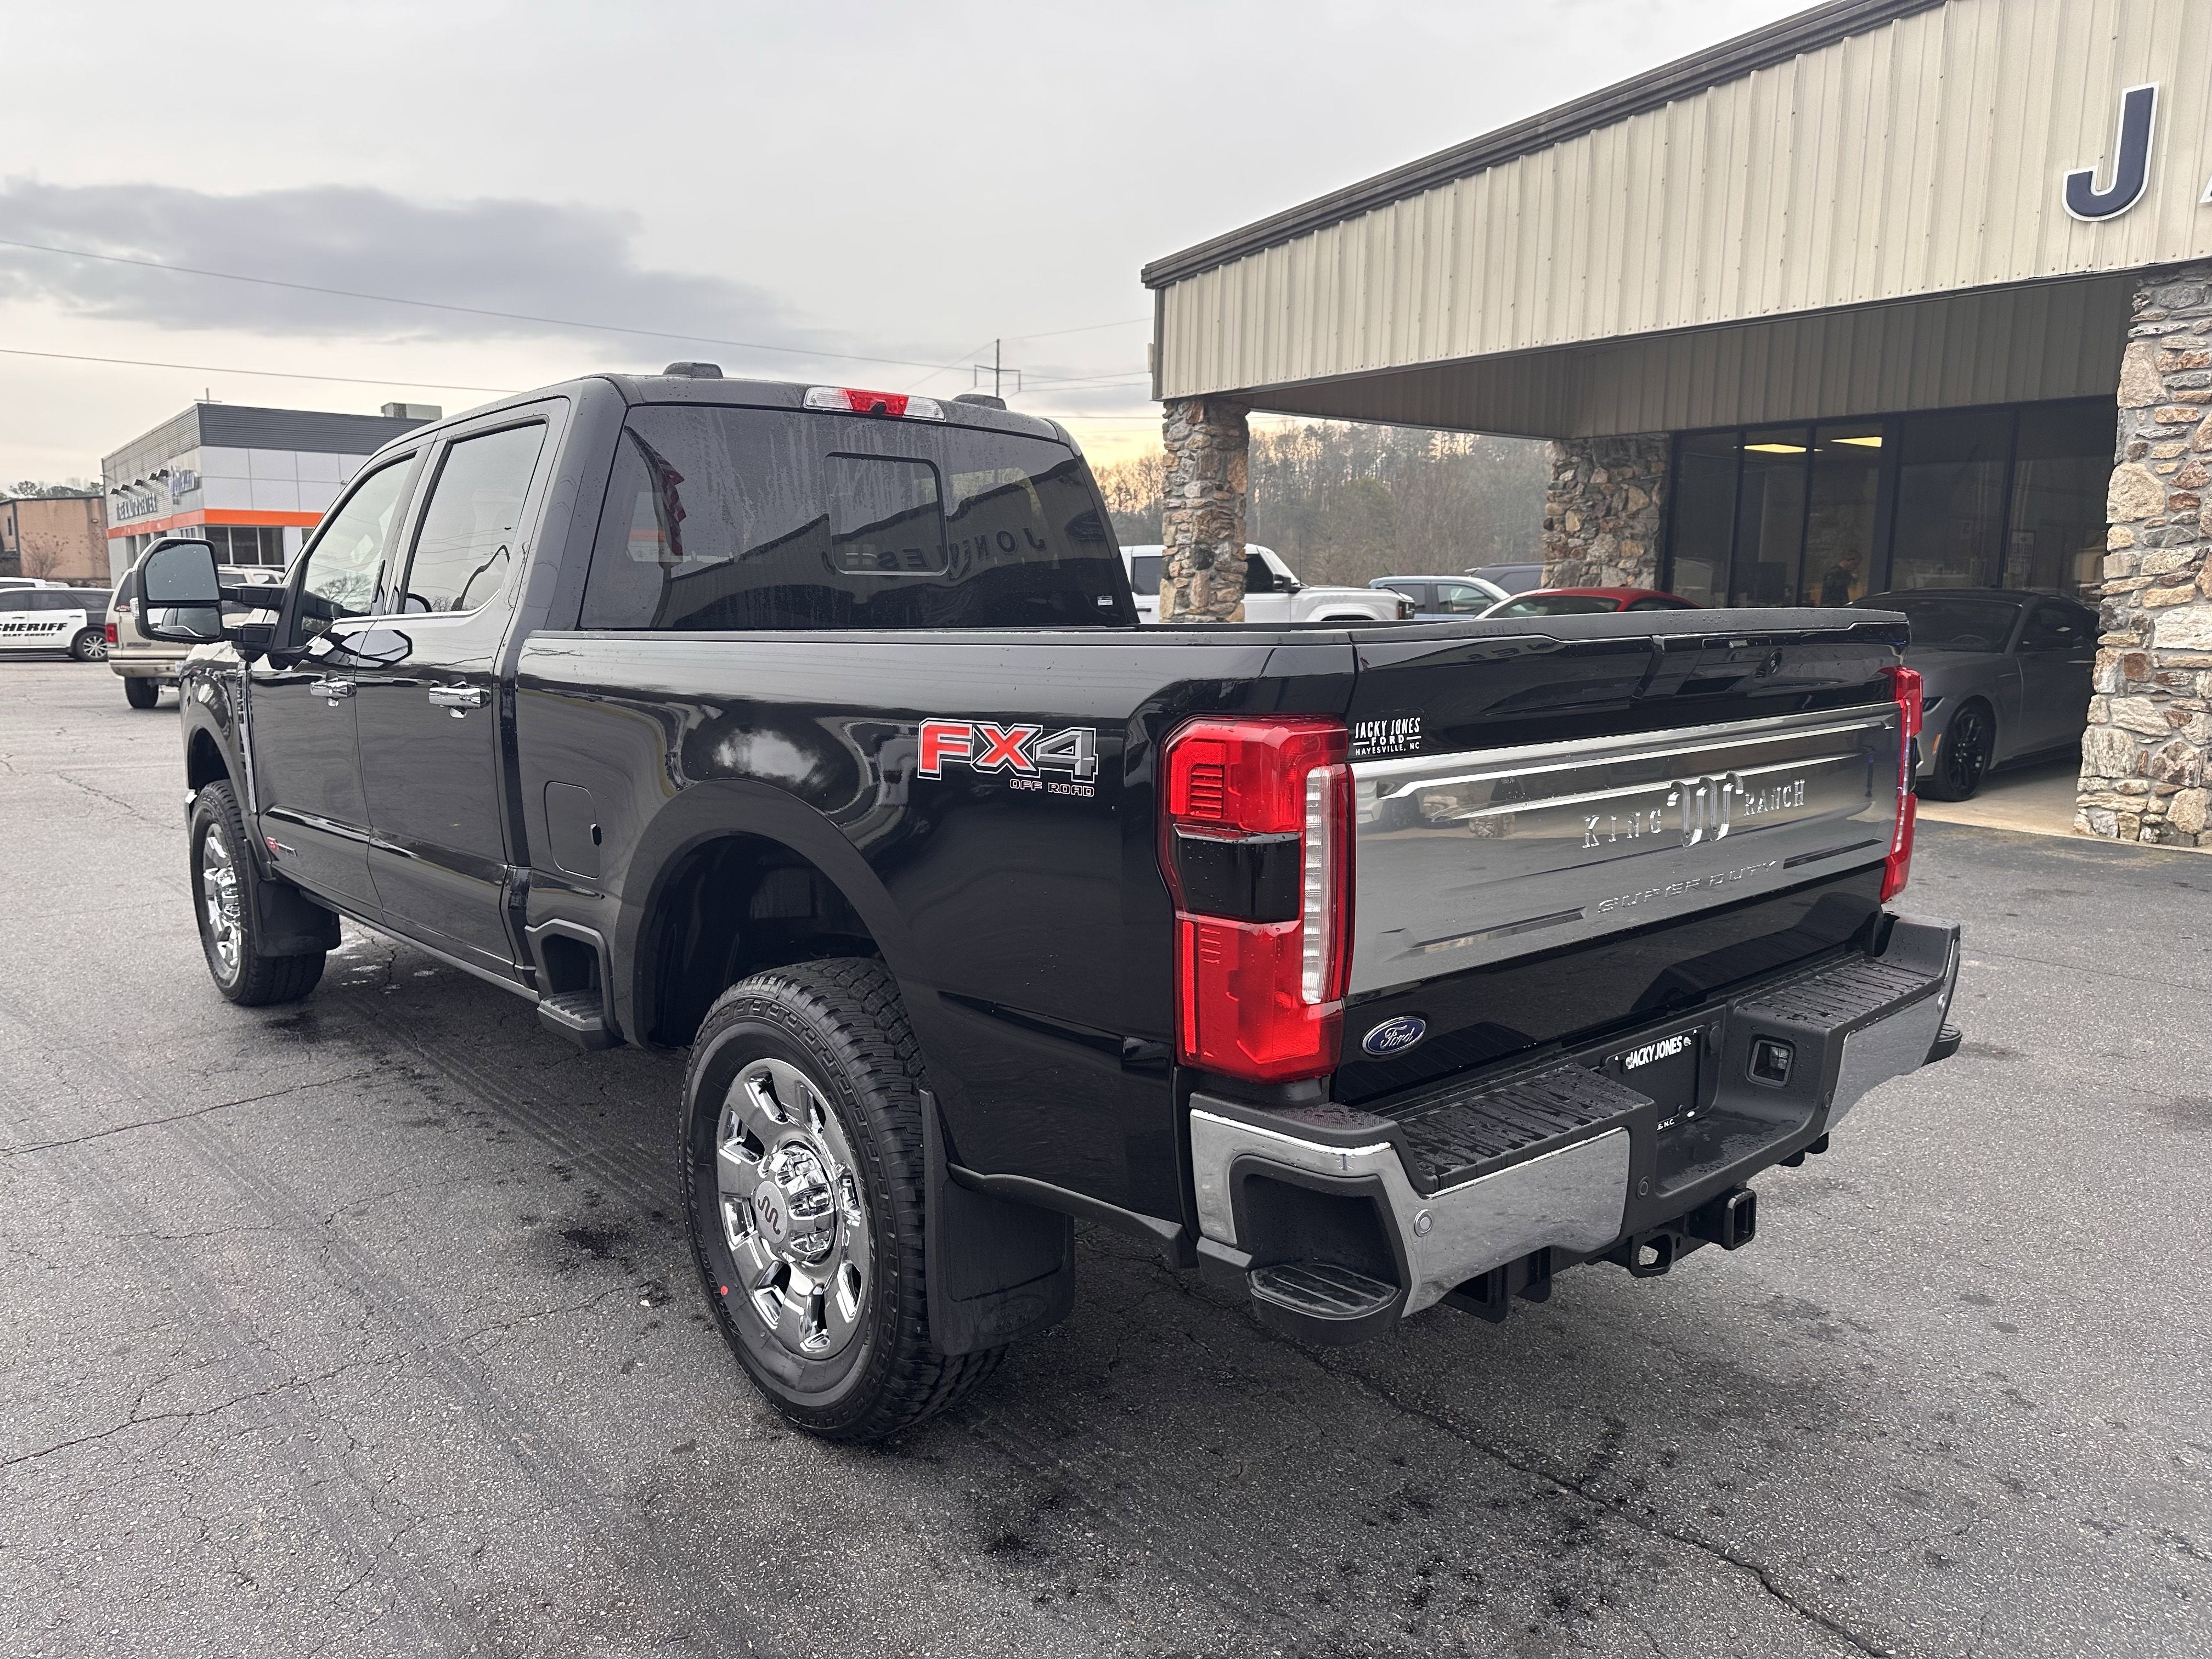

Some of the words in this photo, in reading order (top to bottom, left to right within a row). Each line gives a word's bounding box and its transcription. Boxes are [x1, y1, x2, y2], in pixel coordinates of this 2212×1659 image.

[2061, 81, 2212, 222] J
[1355, 720, 1387, 739] JACKY
[1390, 717, 1420, 736] JONES
[1372, 734, 1404, 746] FORD
[917, 717, 1098, 783] FX4
[1355, 744, 1406, 756] HAYESVILLE,
[1409, 742, 1420, 750] NC
[1009, 778, 1042, 791] OFF
[1048, 782, 1095, 797] ROAD
[1582, 809, 1661, 848] KING
[1743, 778, 1805, 816] RANCH
[1597, 878, 1701, 913] SUPER
[1709, 860, 1777, 887] DUTY
[1380, 1025, 1415, 1049] Ford
[1626, 1044, 1656, 1069] JACKY
[1655, 1035, 1682, 1060] JONES
